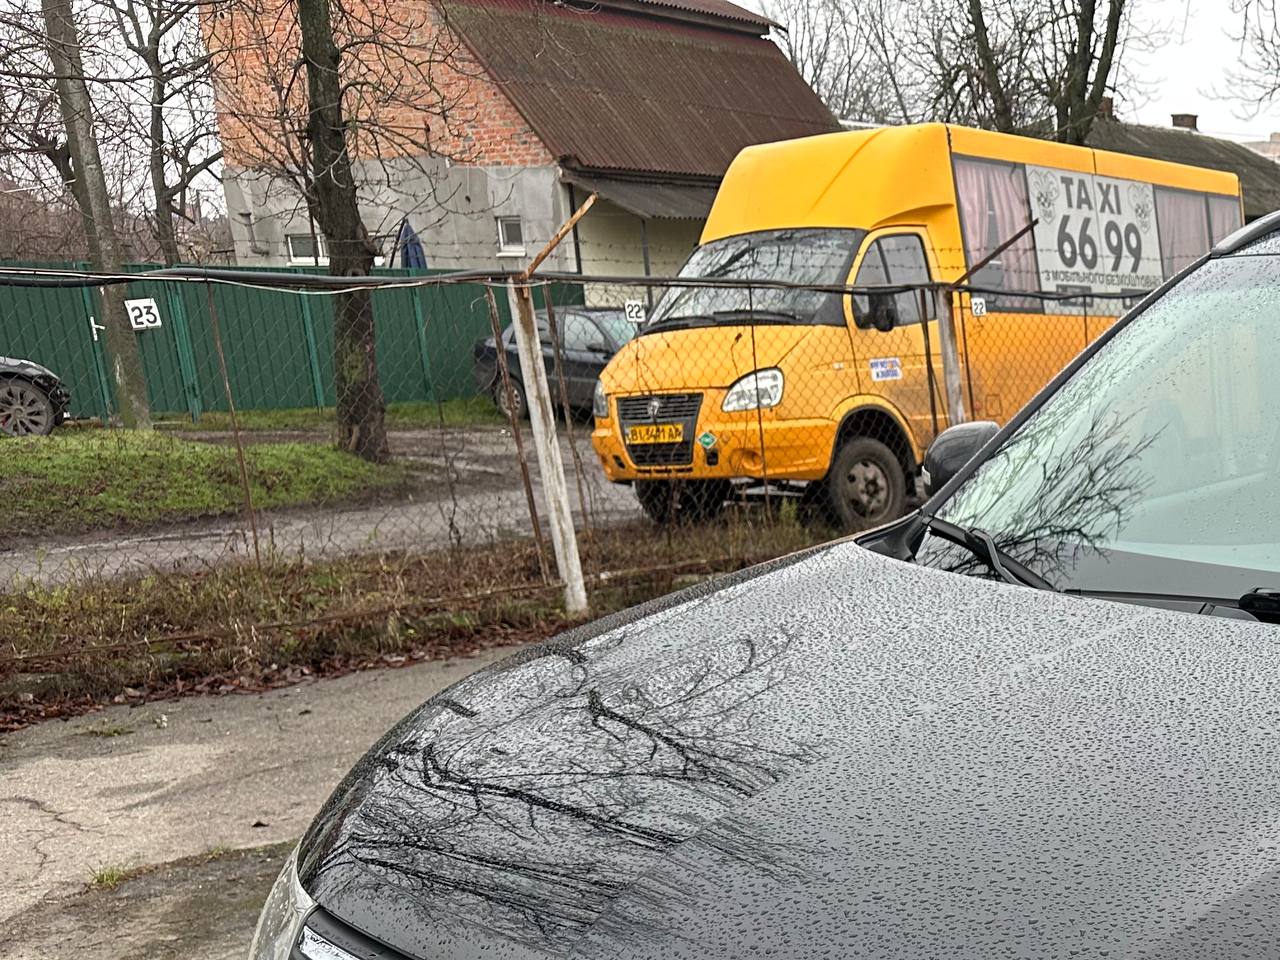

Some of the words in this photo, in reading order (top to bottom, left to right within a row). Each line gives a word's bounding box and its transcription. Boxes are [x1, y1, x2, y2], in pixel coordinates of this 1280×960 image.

[1060, 175, 1122, 215] TAXI
[130, 305, 158, 326] 23
[626, 303, 643, 319] 22
[973, 301, 984, 315] 22
